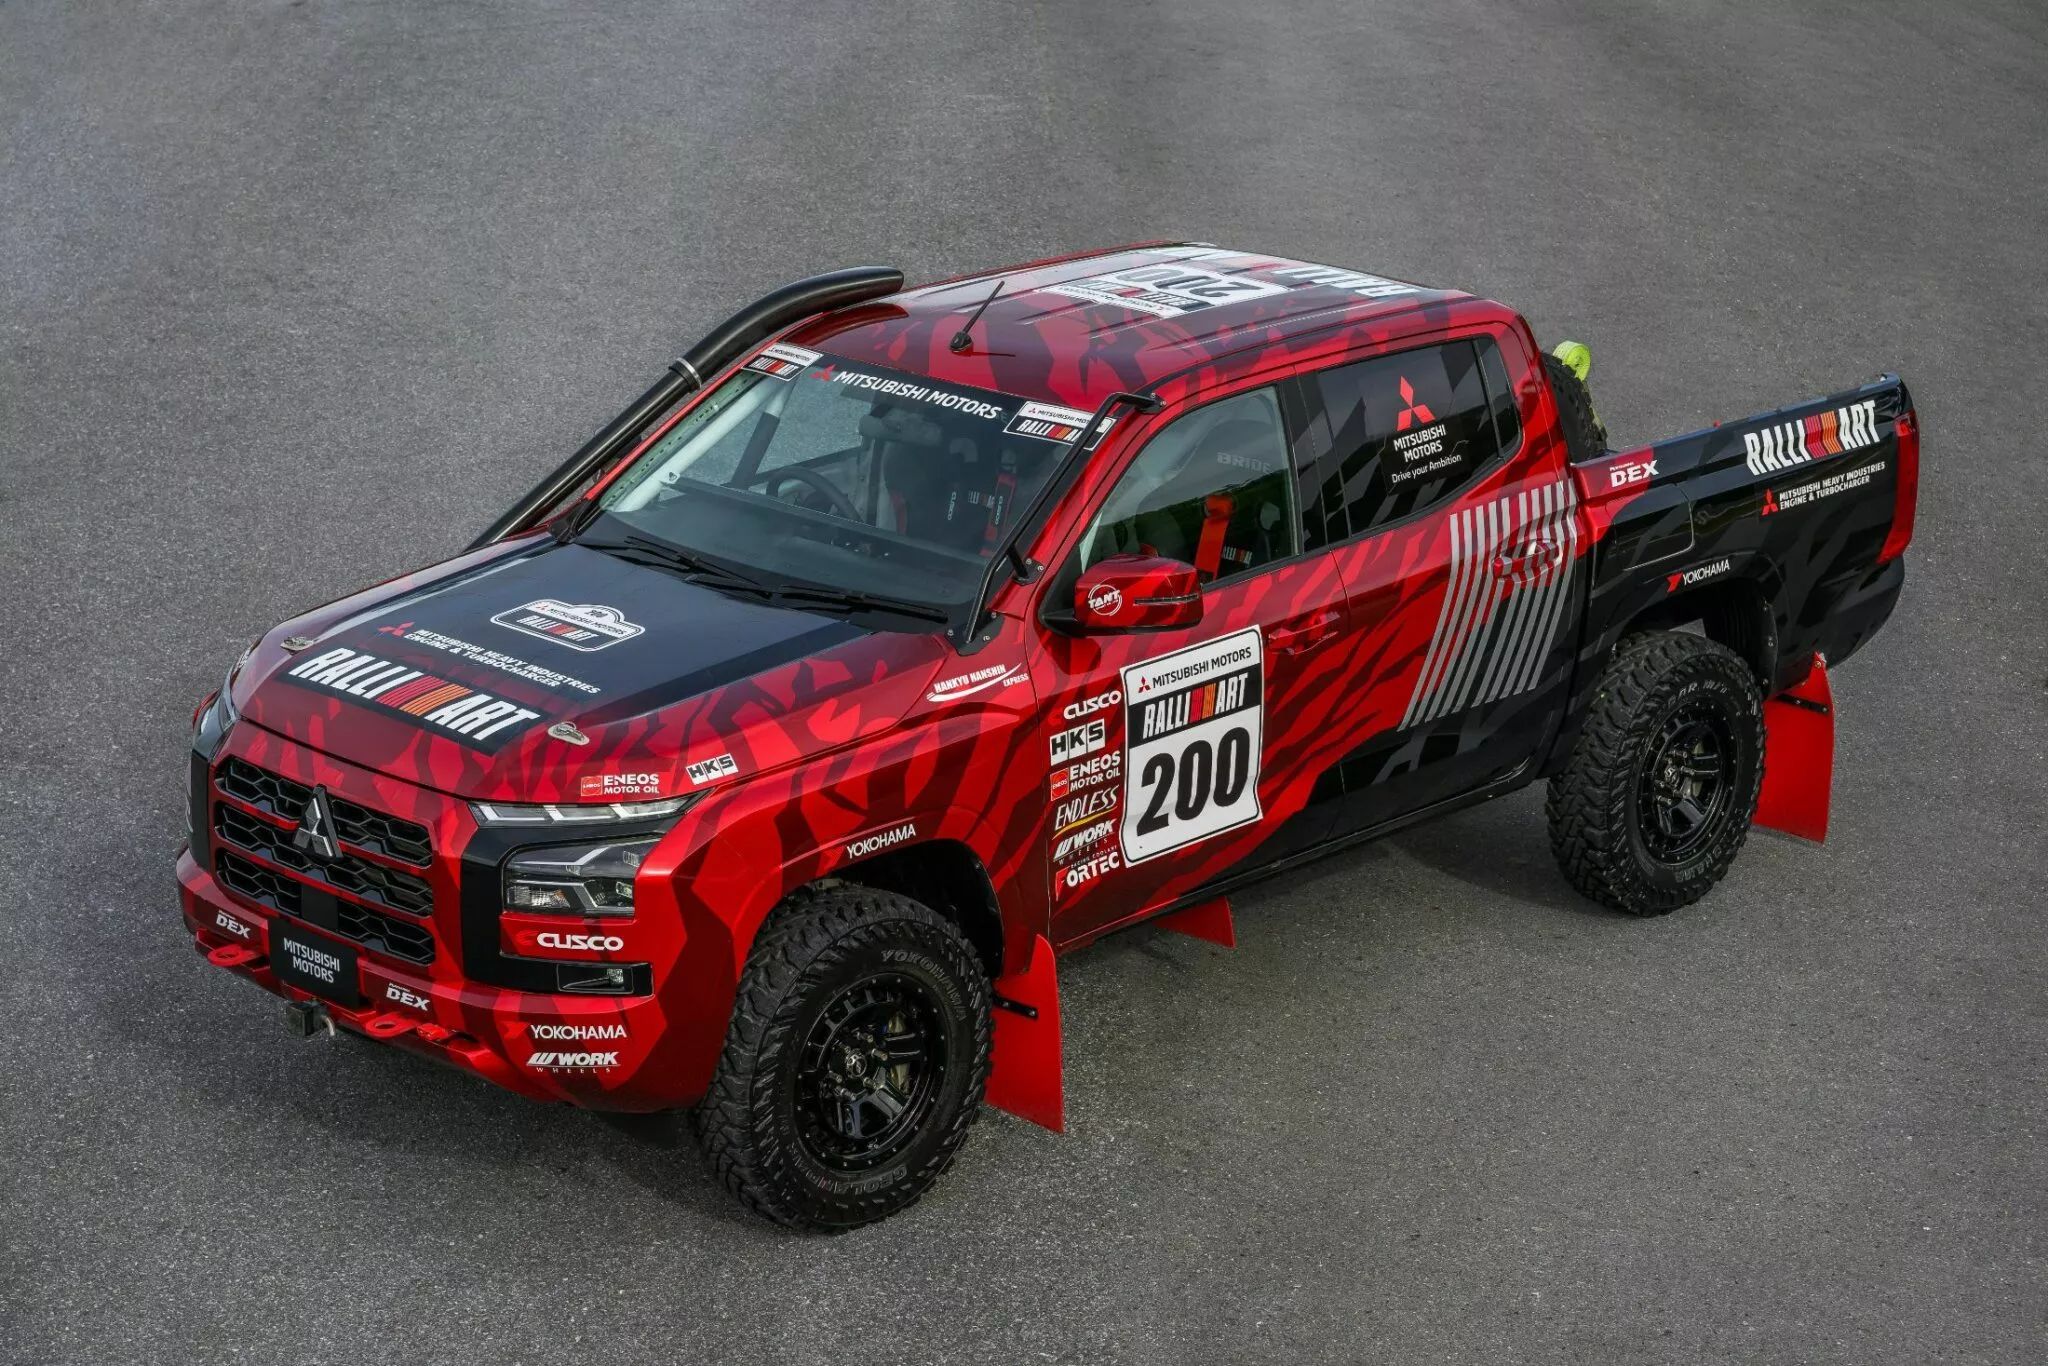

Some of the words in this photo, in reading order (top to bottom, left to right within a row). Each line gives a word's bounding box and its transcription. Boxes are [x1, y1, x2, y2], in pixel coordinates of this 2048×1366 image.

[835, 370, 931, 399] MITSUBISHI
[925, 390, 1003, 420] MOTORS
[1393, 424, 1446, 452] MITSUBISHI
[1403, 440, 1443, 462] MOTORS
[1391, 470, 1411, 483] Drive
[1411, 464, 1428, 479] your
[1429, 454, 1462, 471] Ambition
[1611, 460, 1659, 487] DEX
[1779, 481, 1820, 501] MITSUBISHI
[1822, 473, 1845, 489] HEAVY
[1847, 461, 1885, 480] INDUSTRIES
[1780, 494, 1807, 510] ENGINE
[1808, 492, 1815, 501] &
[1816, 475, 1870, 498] TURBOCHARGER
[1683, 559, 1730, 585] YOKOHAMA
[403, 633, 450, 651] ENGINE
[449, 647, 463, 655] &
[462, 651, 561, 688] TURBOCHARGER
[413, 629, 486, 652] MITSUBISHI
[487, 649, 528, 668] HEAVY
[524, 663, 601, 694] INDUSTRIES
[1152, 661, 1209, 688] MITSUBISHI
[1211, 646, 1252, 670] MOTORS
[1063, 690, 1122, 720] CUSCO
[1051, 721, 1104, 756] HKS
[603, 773, 660, 786] ENEOS
[687, 755, 735, 779] HKS
[1070, 750, 1121, 781] ENEOS
[1070, 773, 1103, 792] MOTOR
[1105, 767, 1120, 780] OIL
[603, 785, 641, 795] MOTOR
[643, 785, 660, 795] OIL
[1136, 726, 1251, 837] 200
[1055, 784, 1120, 831] ENDLESS
[846, 823, 917, 859] YOKOHAMA
[1073, 819, 1117, 849] WORK
[1066, 851, 1120, 888] ORTEC
[216, 914, 251, 939] DEX
[283, 936, 340, 972] MITSUBISHI
[536, 932, 624, 951] CUSCO
[293, 955, 335, 983] MOTORS
[386, 986, 430, 1011] DEX
[530, 1024, 627, 1040] YOKOHAMA
[558, 1052, 619, 1065] WORK
